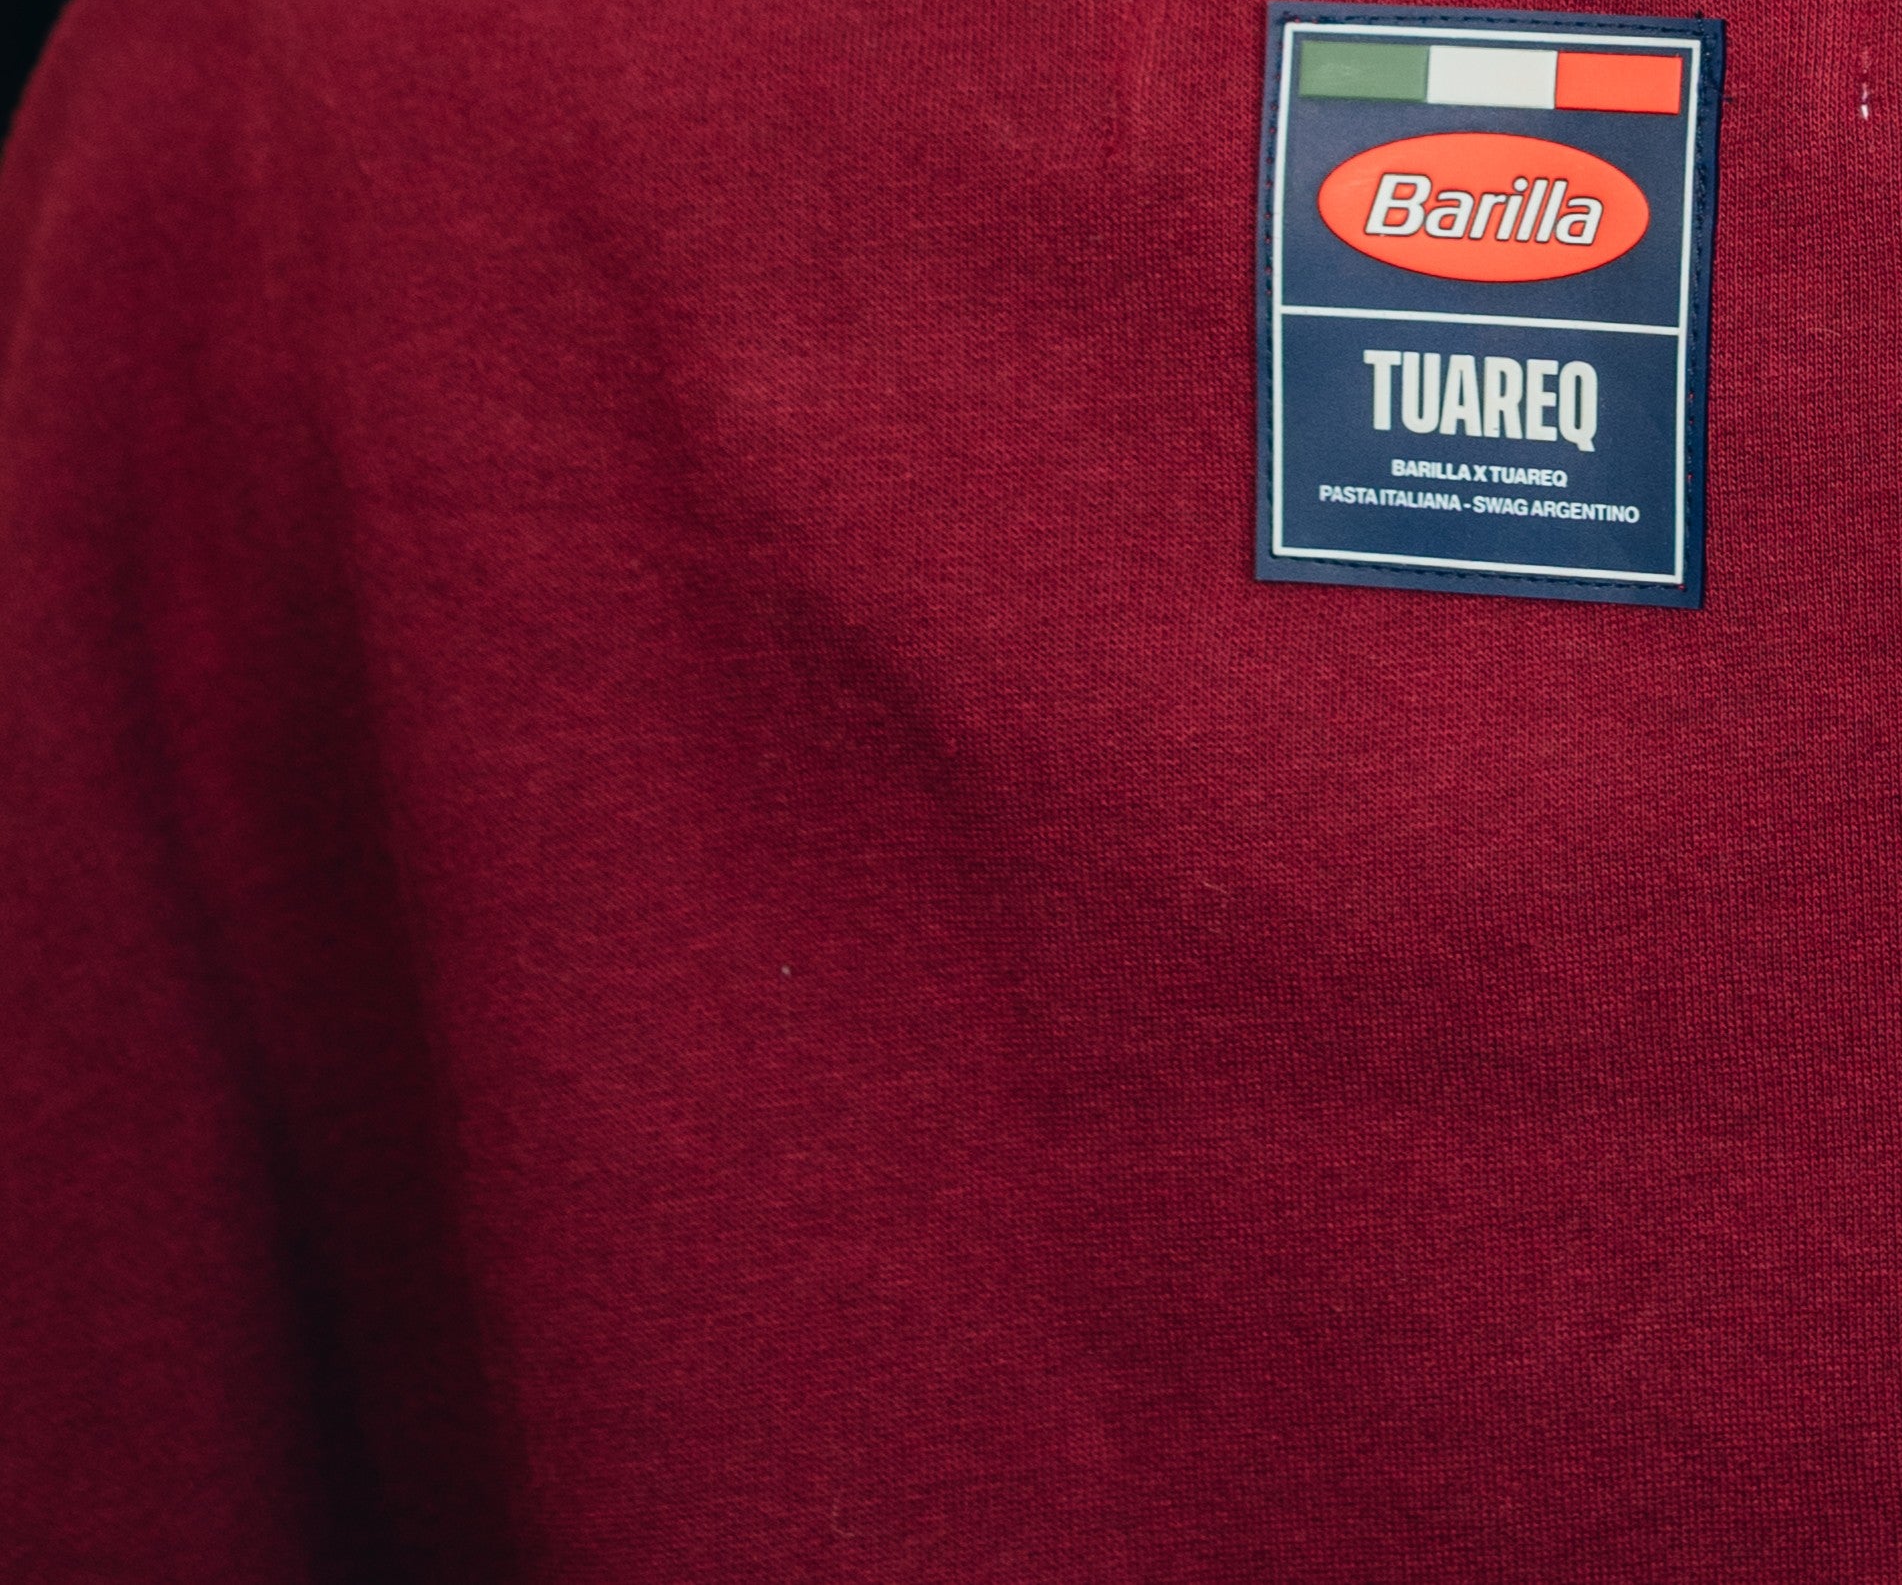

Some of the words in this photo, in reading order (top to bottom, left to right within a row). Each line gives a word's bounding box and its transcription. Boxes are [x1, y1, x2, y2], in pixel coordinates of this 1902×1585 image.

[1365, 172, 1604, 246] Barilla
[1363, 349, 1599, 453] TUAREQ
[1391, 458, 1472, 482] BARILLA
[1473, 464, 1488, 482] X
[1488, 465, 1568, 488] TUAREQ
[1318, 484, 1378, 506] PASTA
[1379, 488, 1462, 511] ITALIANA
[1472, 495, 1529, 516] SWAG
[1530, 499, 1641, 524] ARGENTINO
